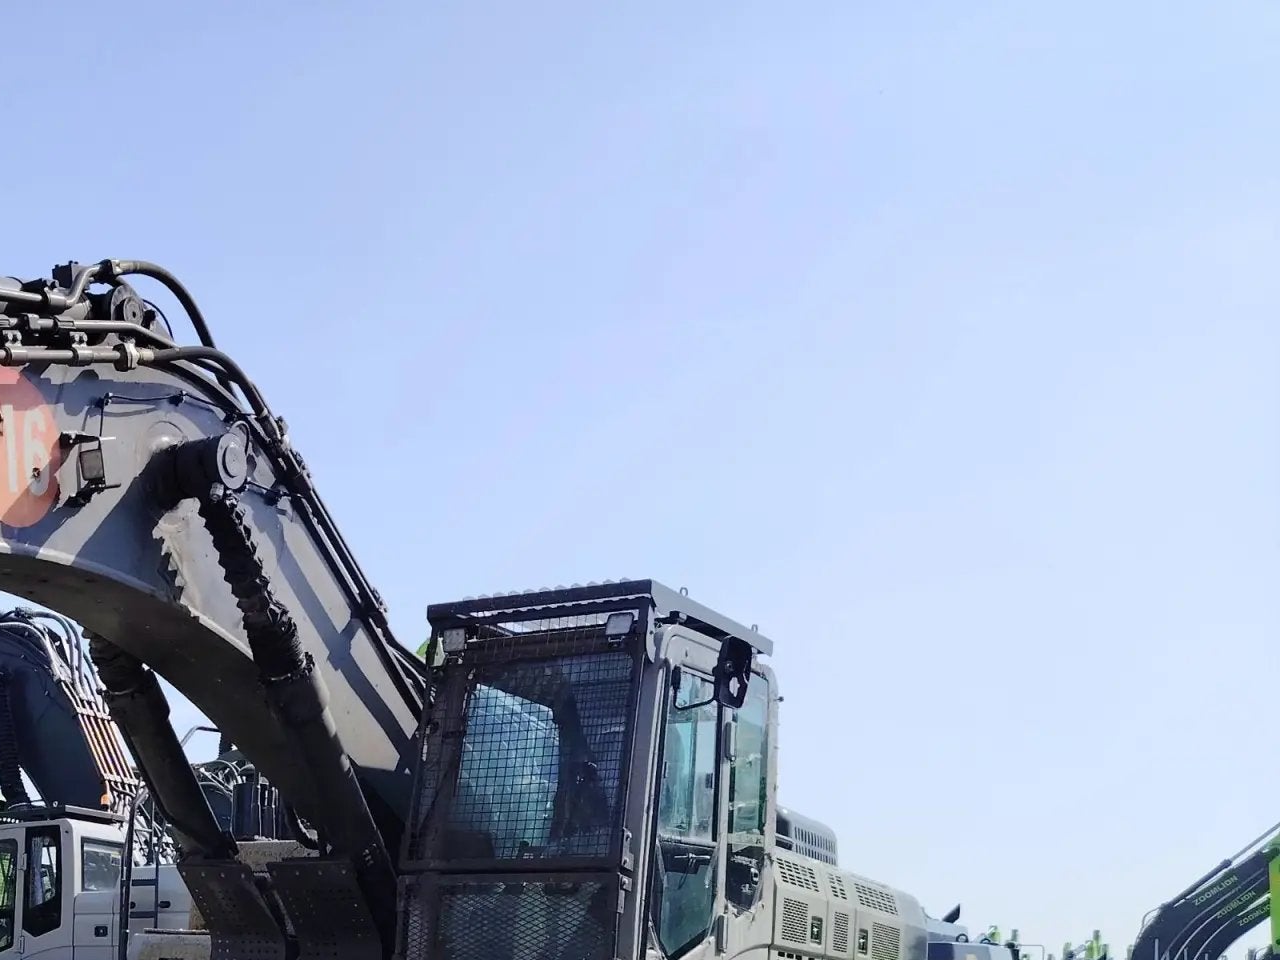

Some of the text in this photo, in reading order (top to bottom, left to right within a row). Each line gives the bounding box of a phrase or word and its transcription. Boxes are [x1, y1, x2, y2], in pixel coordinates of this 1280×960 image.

[1193, 875, 1239, 906] ZOOMLION
[1215, 890, 1257, 919] ZOOMLION
[1238, 904, 1271, 927] ZOOMLIO
